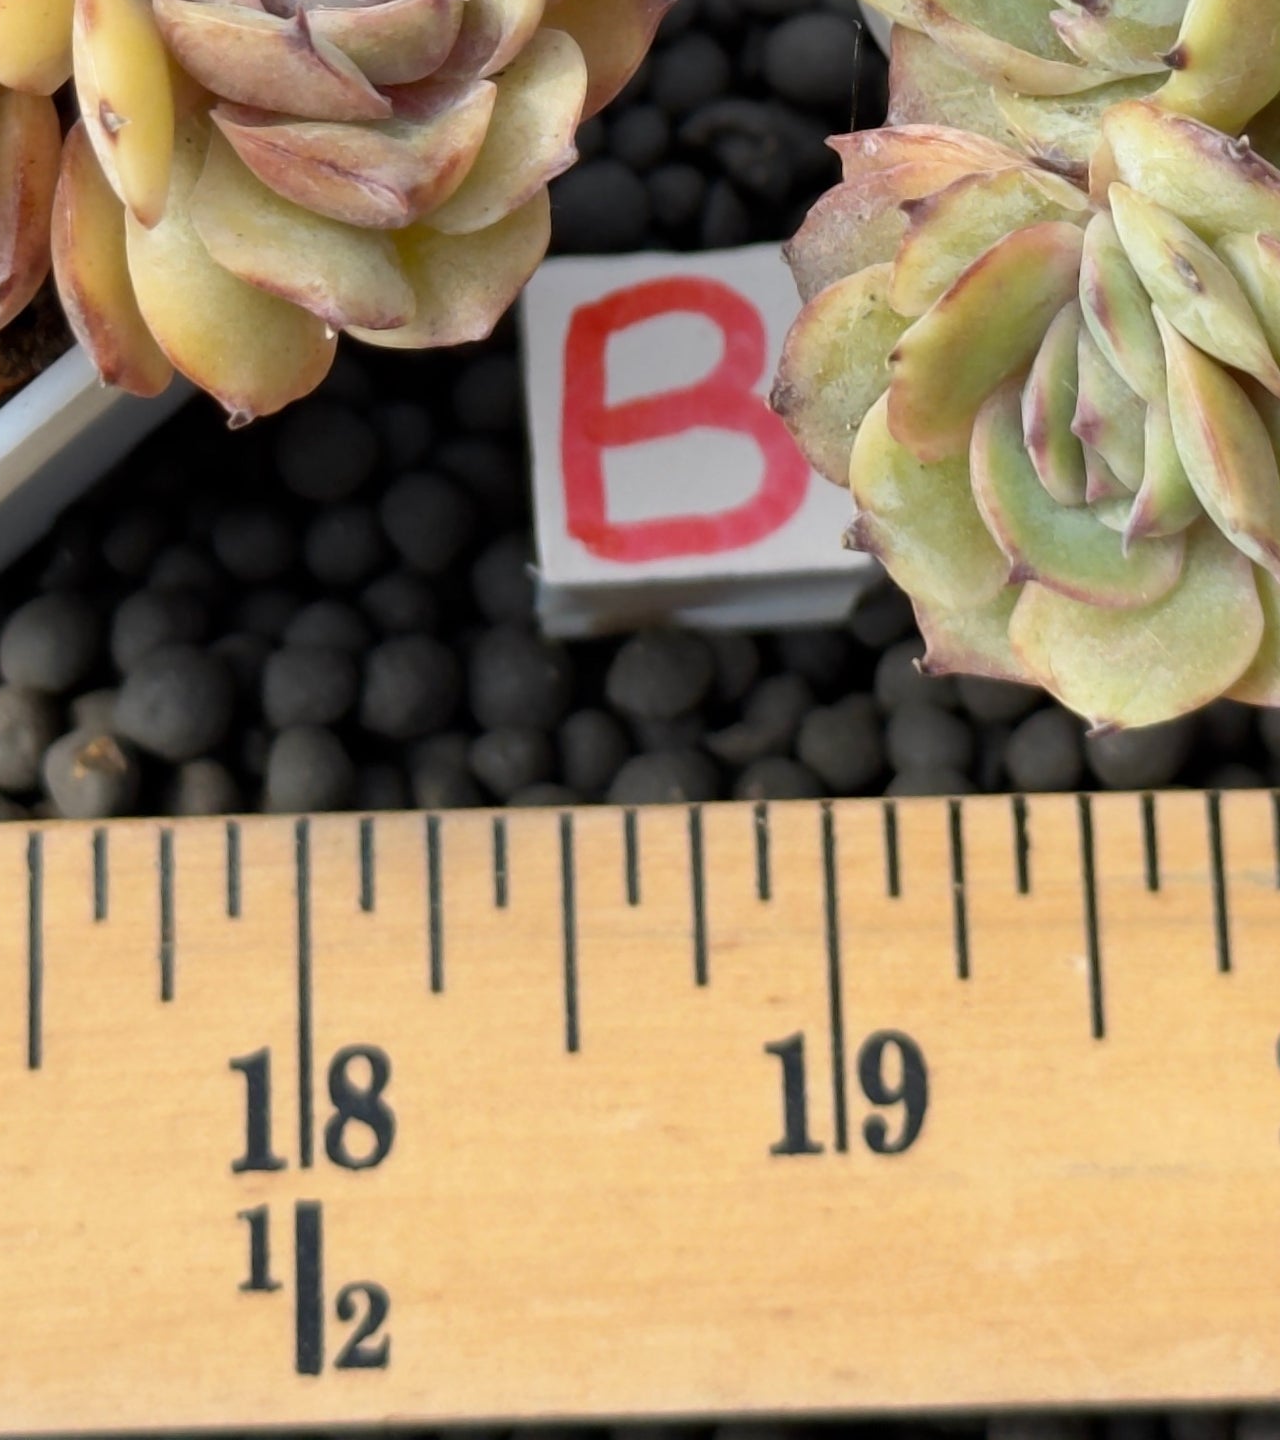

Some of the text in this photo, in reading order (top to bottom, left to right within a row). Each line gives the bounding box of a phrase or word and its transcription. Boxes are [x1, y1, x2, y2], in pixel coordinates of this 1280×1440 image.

[560, 274, 811, 563] B
[229, 1043, 396, 1173] 18
[764, 1028, 929, 1155] 19
